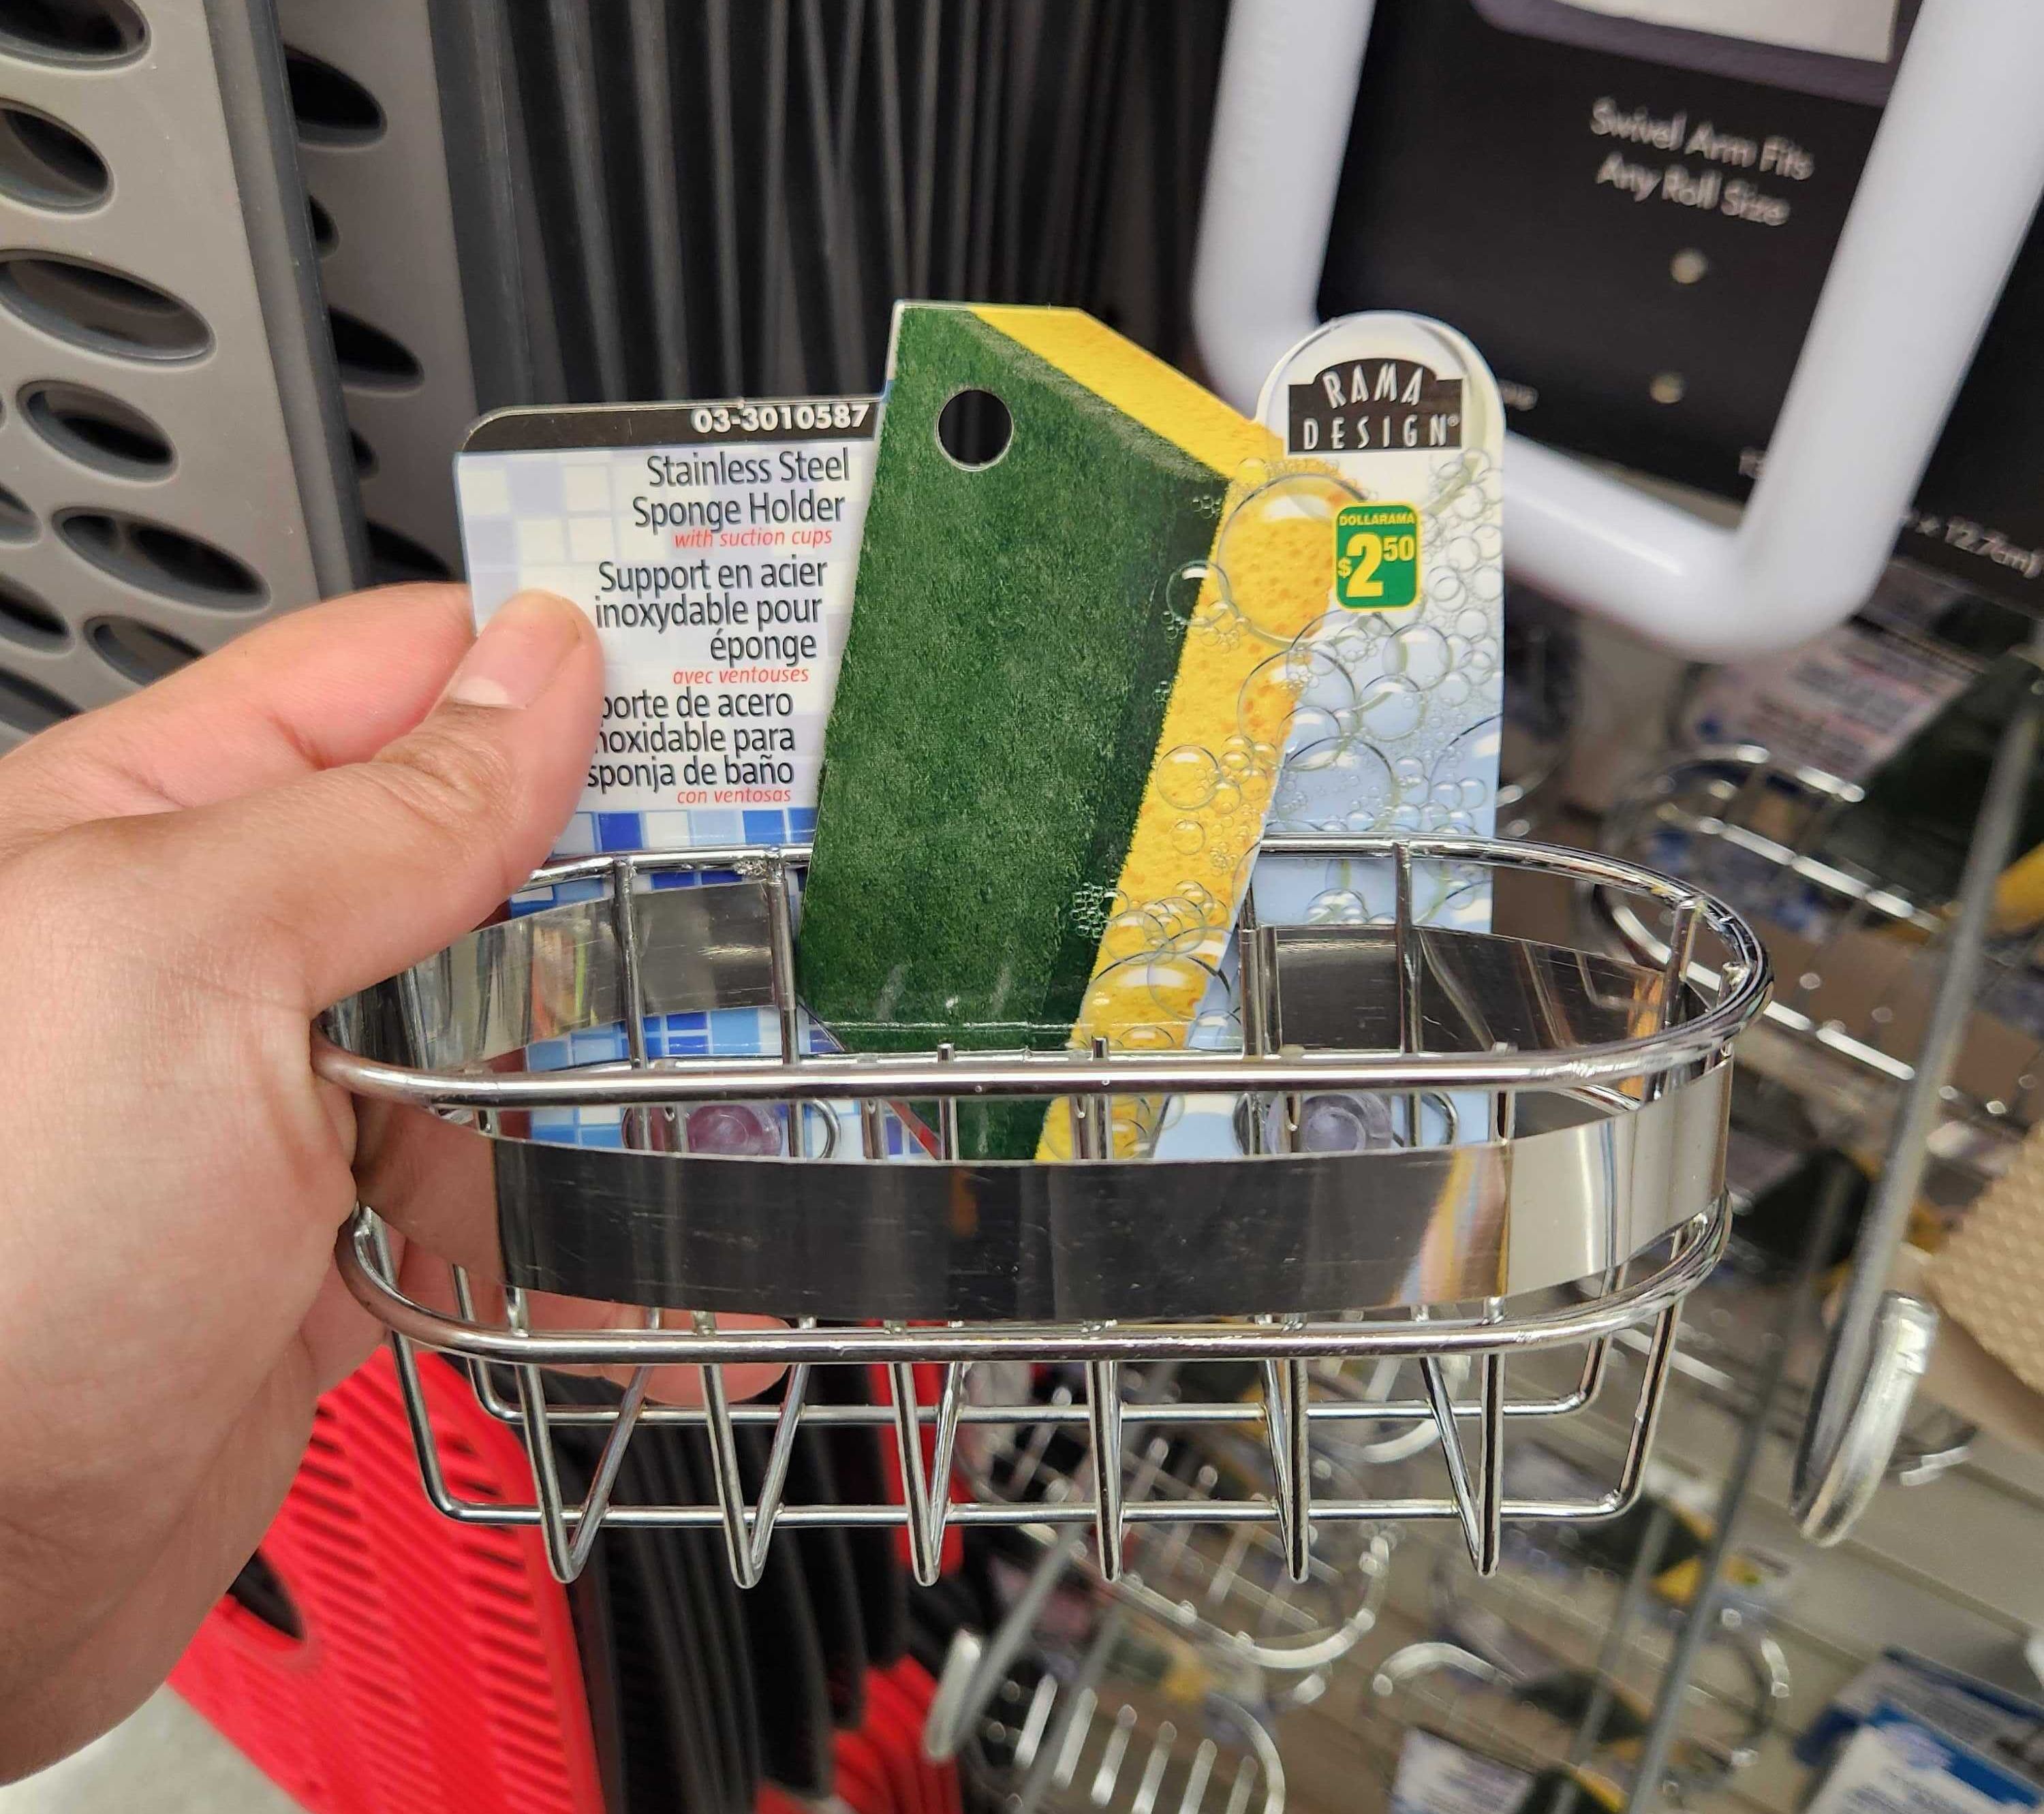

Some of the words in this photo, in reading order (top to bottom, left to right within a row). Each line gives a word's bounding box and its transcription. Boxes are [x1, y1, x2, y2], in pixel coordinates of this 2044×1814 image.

[1590, 96, 1687, 151] Swivel
[1685, 121, 1758, 168] Arm
[1759, 136, 1815, 181] Fits
[1596, 151, 1662, 202] Any
[1662, 163, 1722, 210] Roll
[1720, 178, 1791, 226] Size
[1322, 362, 1424, 409] RAMA
[691, 403, 870, 434] 03-3010587
[647, 451, 772, 488] Stainless
[779, 447, 850, 484] Steel
[632, 496, 742, 535] Sponge
[749, 488, 846, 525] Holder
[1339, 514, 1415, 527] DOLLARAMA
[675, 529, 713, 548] with
[719, 529, 785, 548] suction
[791, 528, 833, 548] cups
[598, 559, 711, 599] Support
[717, 563, 753, 589] en
[760, 554, 828, 587] acier
[595, 593, 749, 634] inoxydable
[757, 597, 822, 632] pour
[710, 628, 818, 668] éponge
[672, 670, 714, 685] avec
[719, 667, 809, 684] ventouses
[602, 688, 670, 726] porte
[676, 686, 711, 718] de
[717, 691, 794, 718] acero
[595, 721, 727, 754] noxidable
[734, 727, 796, 759] para
[587, 755, 676, 795] sponja
[683, 755, 718, 786] de
[724, 753, 795, 785] baño
[677, 790, 708, 804] con
[714, 788, 791, 803] ventosas
